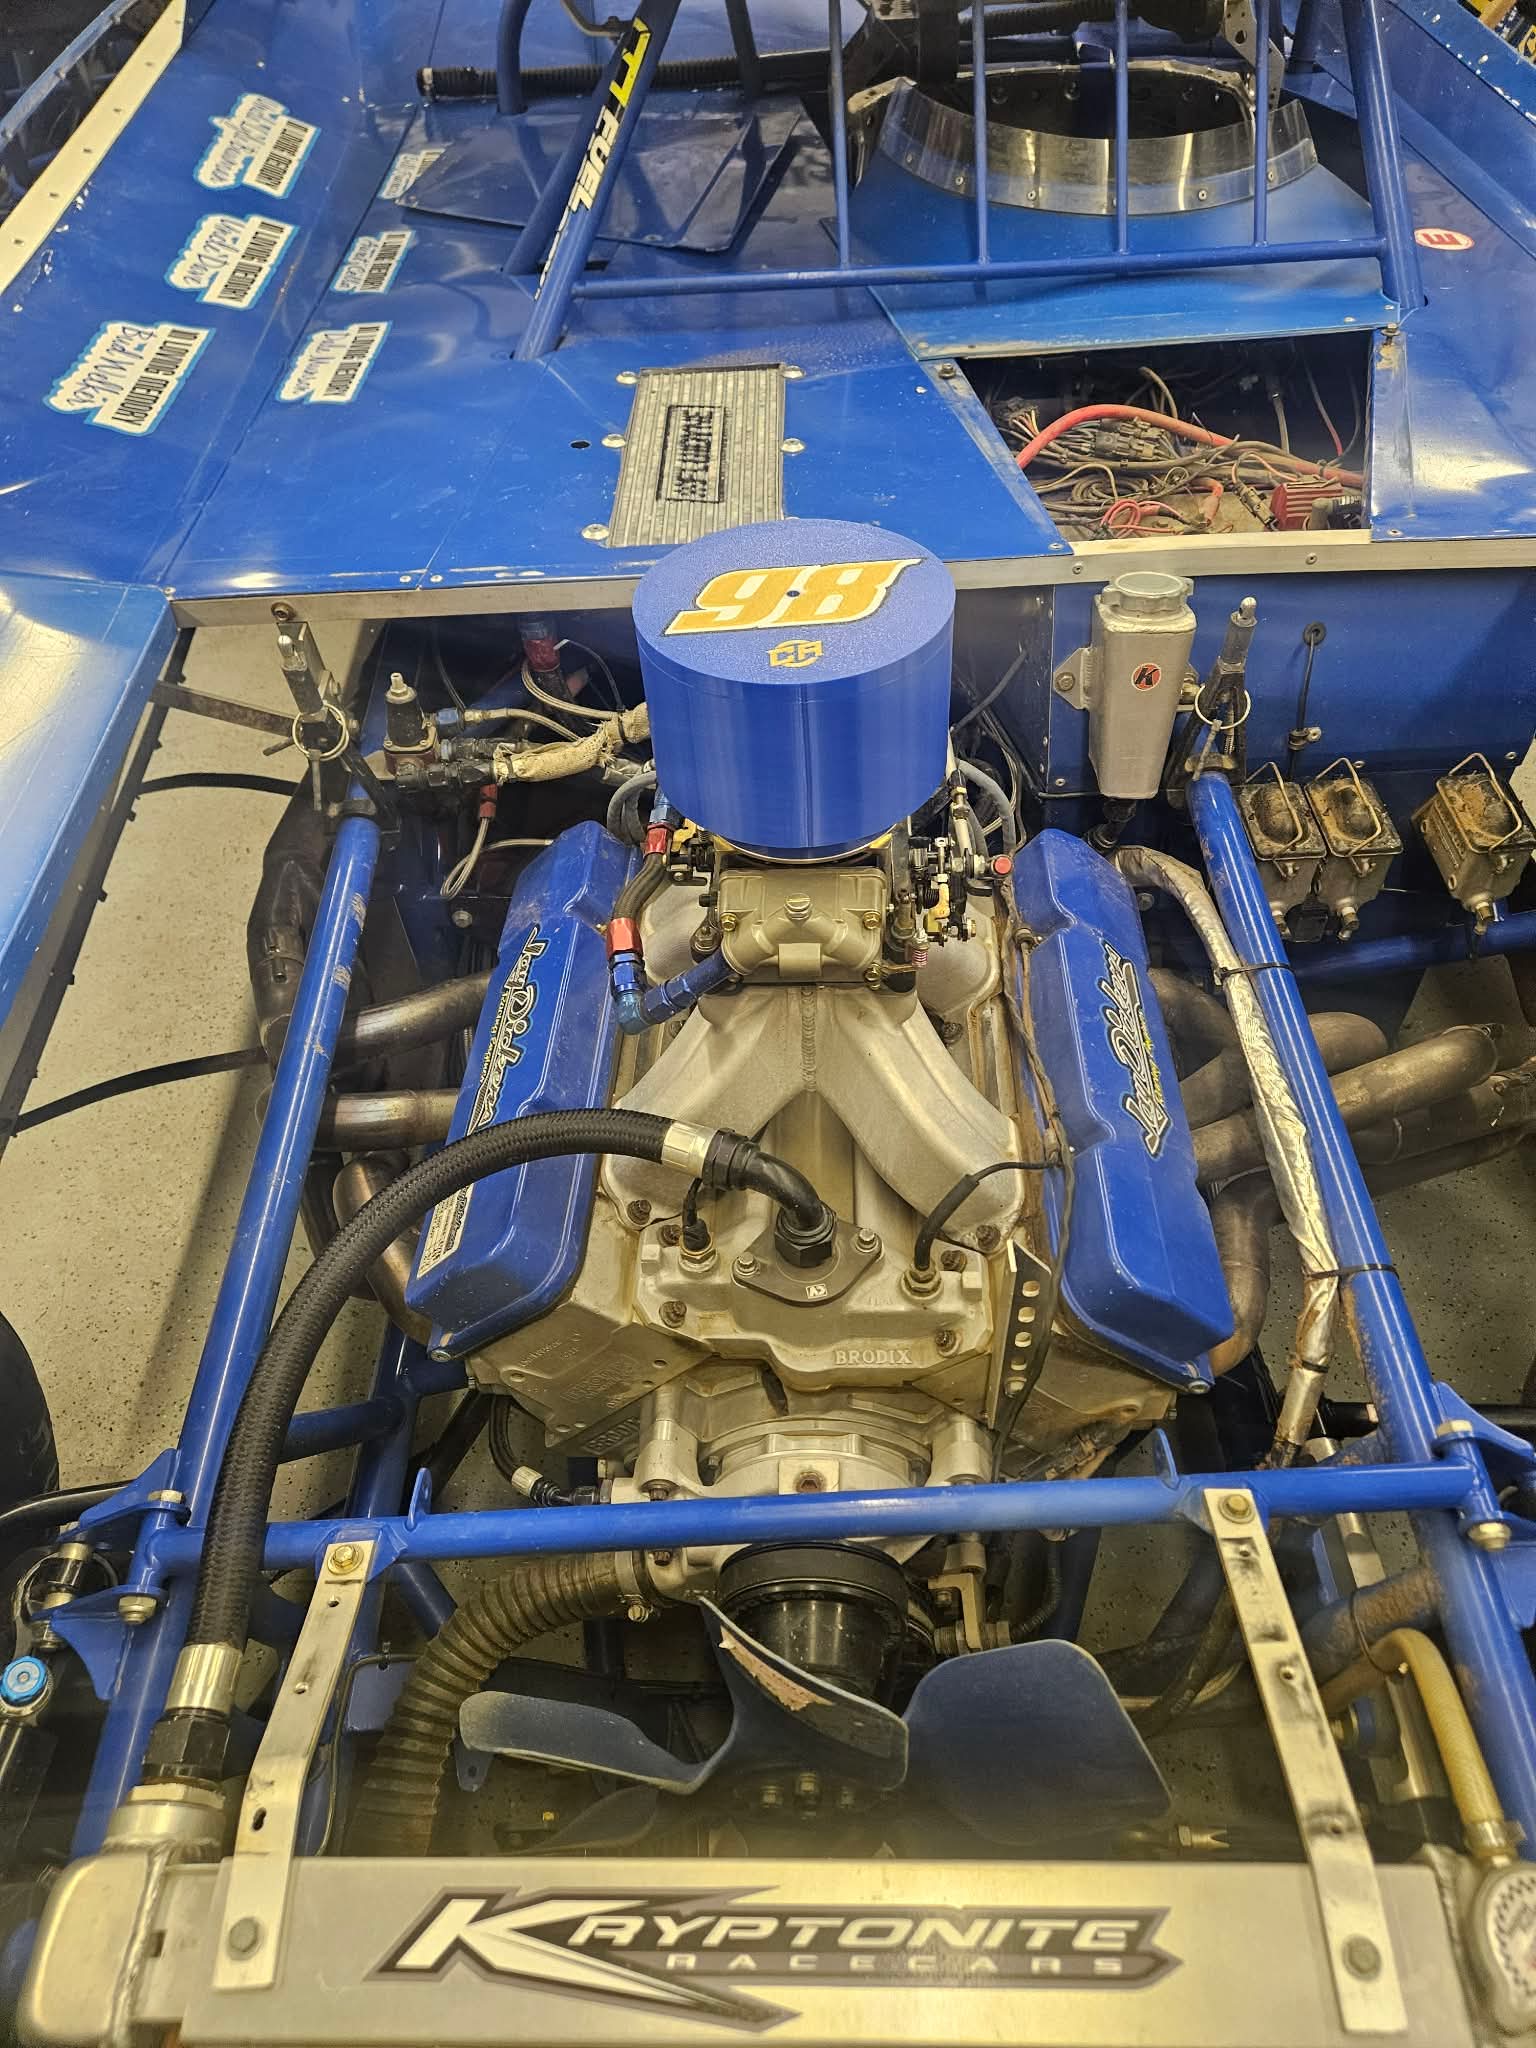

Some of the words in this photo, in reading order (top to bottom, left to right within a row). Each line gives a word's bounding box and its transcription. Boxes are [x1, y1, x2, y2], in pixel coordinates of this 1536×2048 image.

[255, 152, 293, 191] MEMORY
[571, 107, 620, 212] FUEL
[241, 231, 281, 263] LOVING
[217, 262, 263, 303] MEMORY
[167, 329, 201, 341] IN
[343, 335, 377, 361] LOVING
[144, 340, 193, 376] LOVING
[323, 362, 362, 396] MEMORY
[111, 376, 169, 426] MEMORY
[663, 558, 924, 636] 98
[470, 984, 535, 1130] Dickens
[835, 1349, 912, 1366] BRODIX
[395, 1898, 1140, 2006] KRYPTONITE
